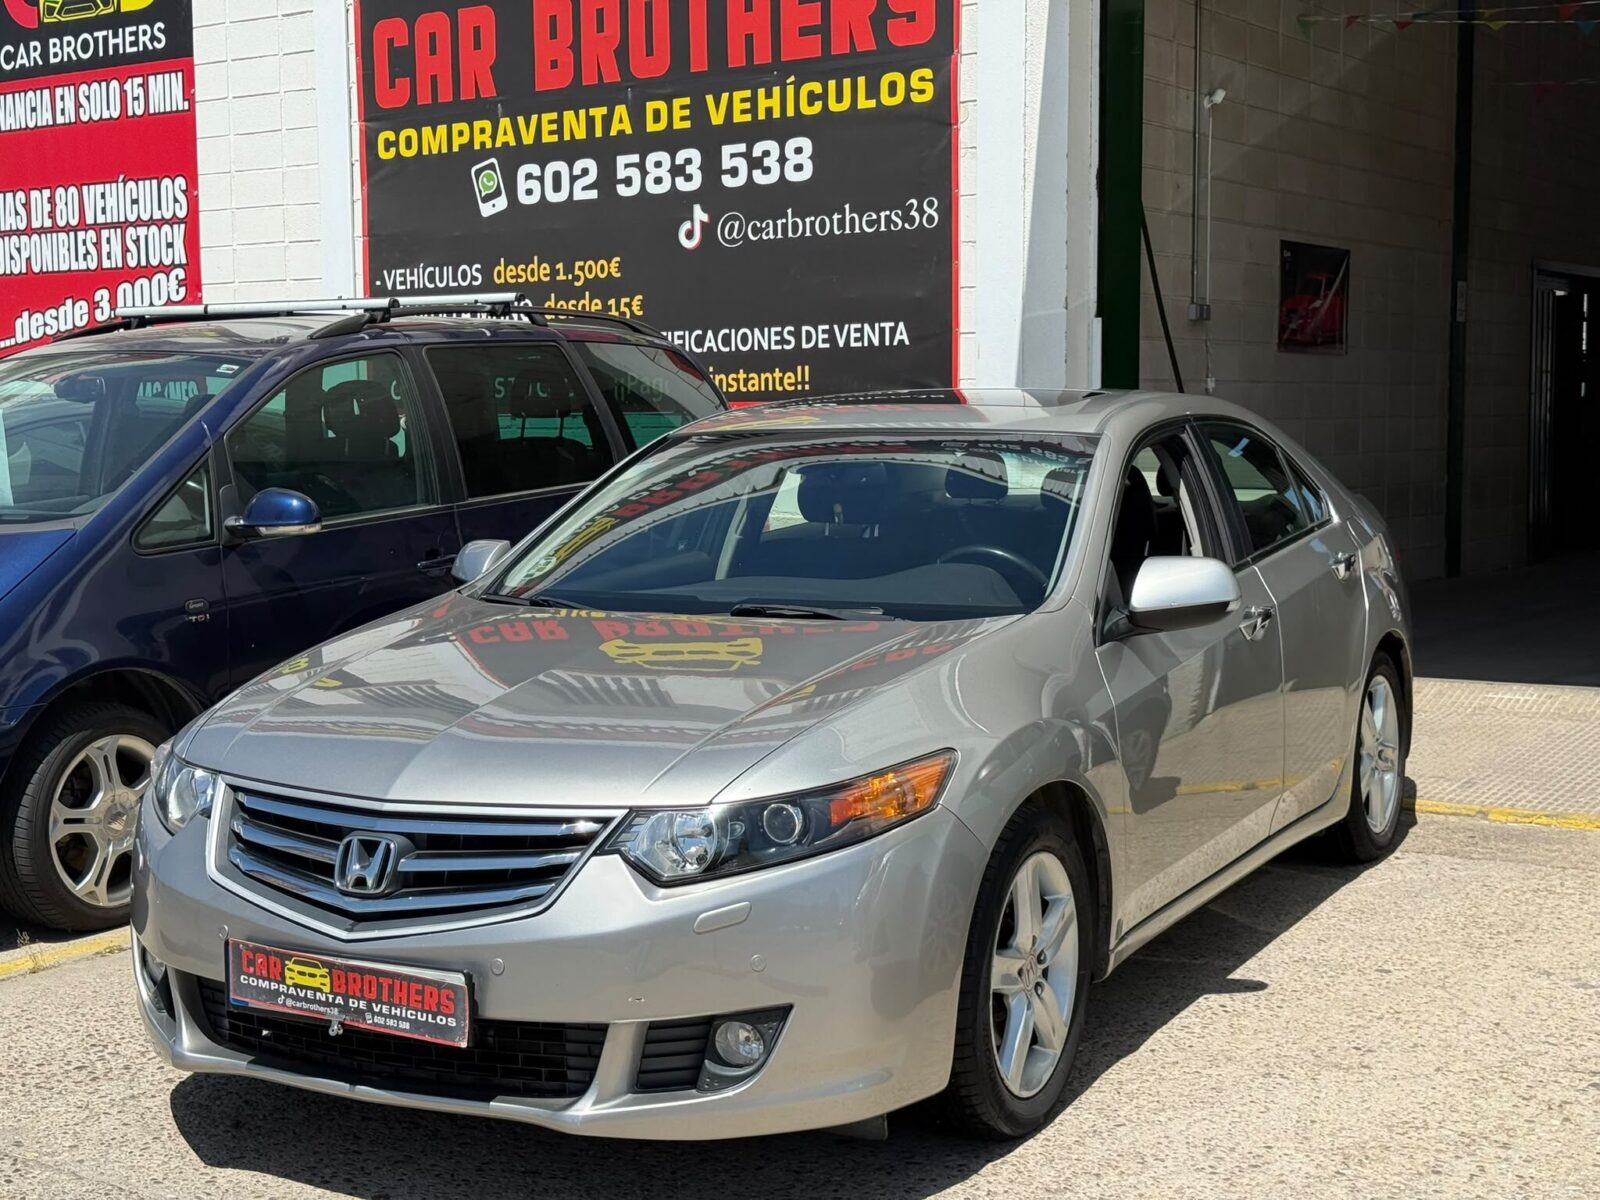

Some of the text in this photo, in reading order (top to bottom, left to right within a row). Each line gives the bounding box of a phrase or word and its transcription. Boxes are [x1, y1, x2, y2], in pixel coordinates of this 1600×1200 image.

[0, 21, 167, 71] CAR BROTHERS
[373, 17, 497, 109] CAR
[55, 85, 76, 125] EN
[79, 79, 121, 123] SOLO
[123, 76, 145, 117] 15
[148, 71, 189, 115] MIN.
[377, 67, 934, 160] COMPRAVENTA DE VEHÍCULOS
[516, 136, 814, 206] 602 583 538
[30, 187, 53, 229] DE
[55, 184, 80, 227] 80
[82, 174, 188, 225] VEHÍCULOS
[717, 197, 939, 247] @carbrothers38
[101, 227, 123, 269] EN
[126, 223, 188, 269] STOCK
[493, 256, 550, 285] desde
[555, 256, 622, 287] 1.500€
[544, 291, 603, 320] desde
[607, 294, 644, 319] 15€
[801, 325, 830, 350] DE
[833, 321, 910, 348] VENTA
[240, 975, 457, 1027] COMPRAVENTA DE VEHÍCULOS
[241, 950, 455, 1014] CAR BROTHERS
